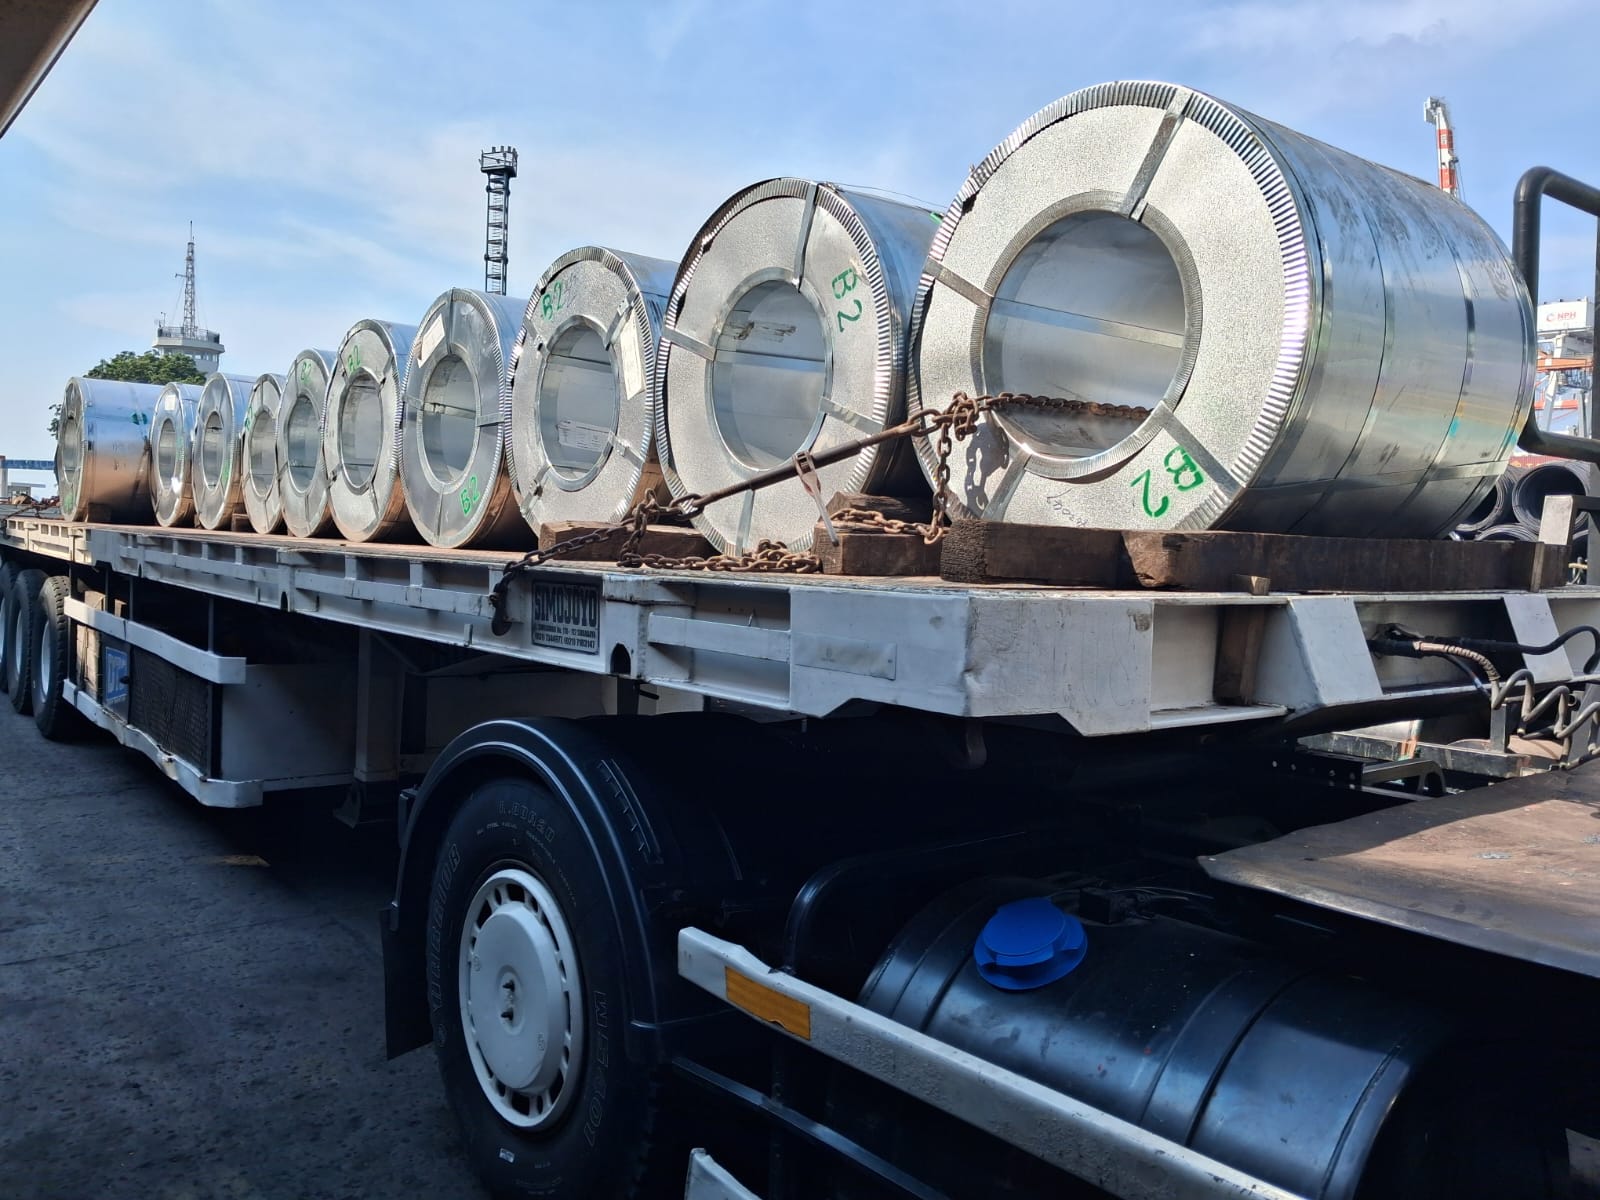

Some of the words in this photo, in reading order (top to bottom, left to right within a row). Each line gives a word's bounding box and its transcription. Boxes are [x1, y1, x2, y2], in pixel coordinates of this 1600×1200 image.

[542, 281, 565, 320] B2
[831, 267, 863, 333] B2
[460, 476, 480, 515] B2
[1130, 445, 1204, 518] B2
